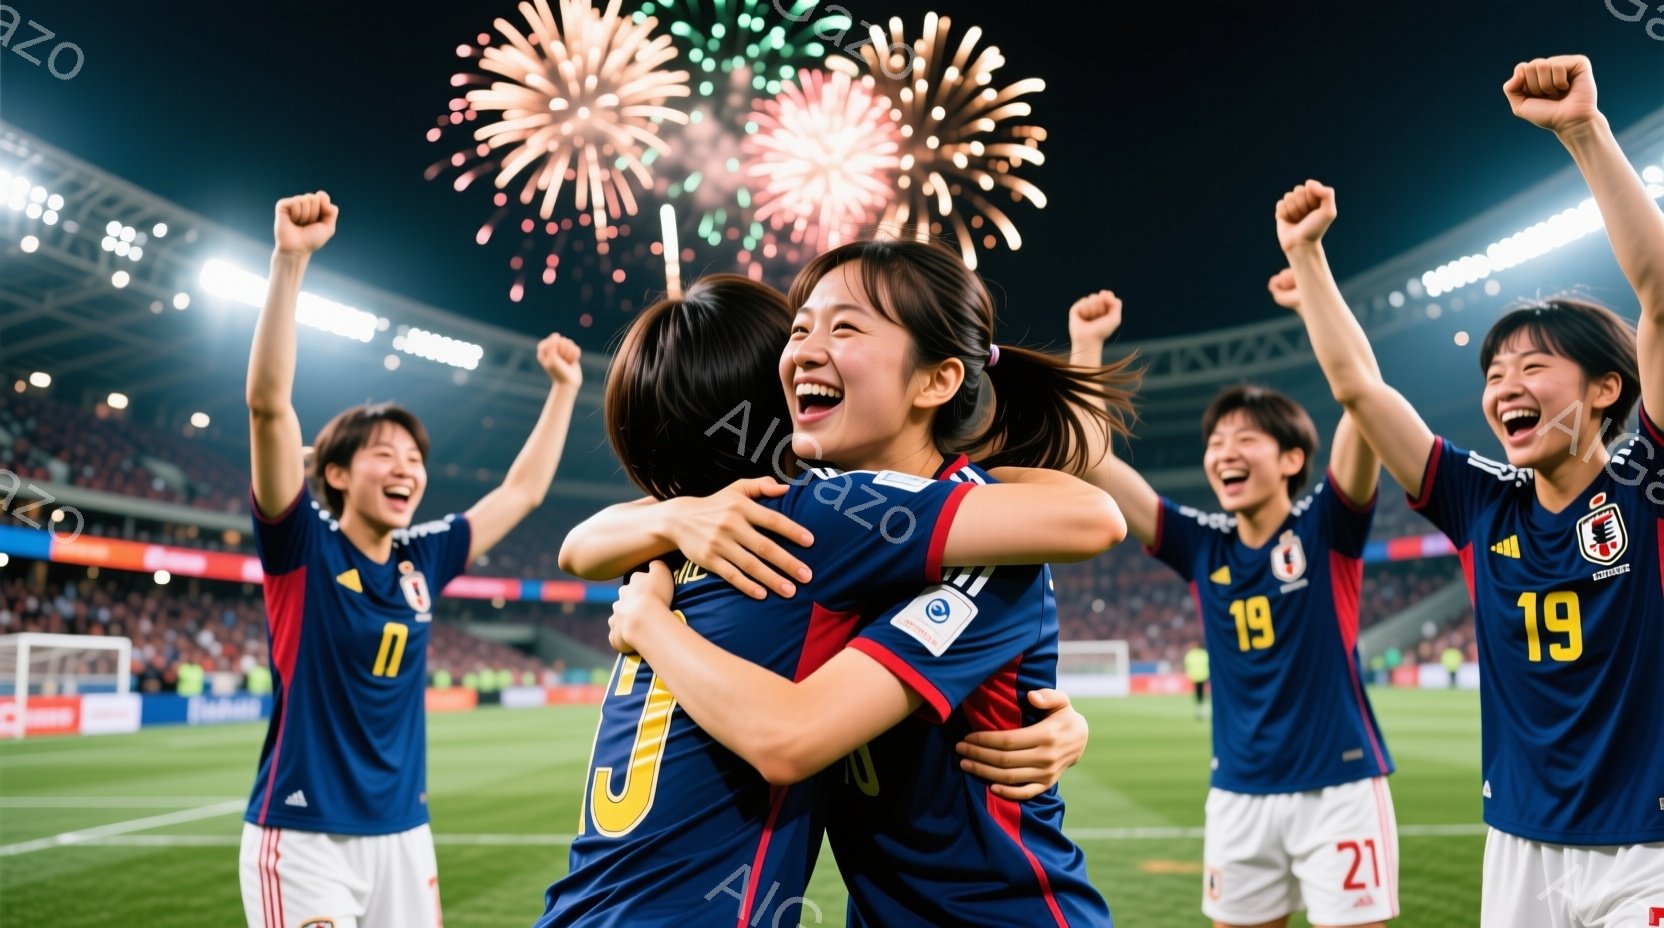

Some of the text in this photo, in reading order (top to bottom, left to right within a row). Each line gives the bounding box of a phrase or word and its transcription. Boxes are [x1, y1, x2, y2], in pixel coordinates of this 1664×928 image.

[1228, 595, 1275, 652] 19
[1517, 590, 1583, 662] 19
[1337, 838, 1380, 890] 21
